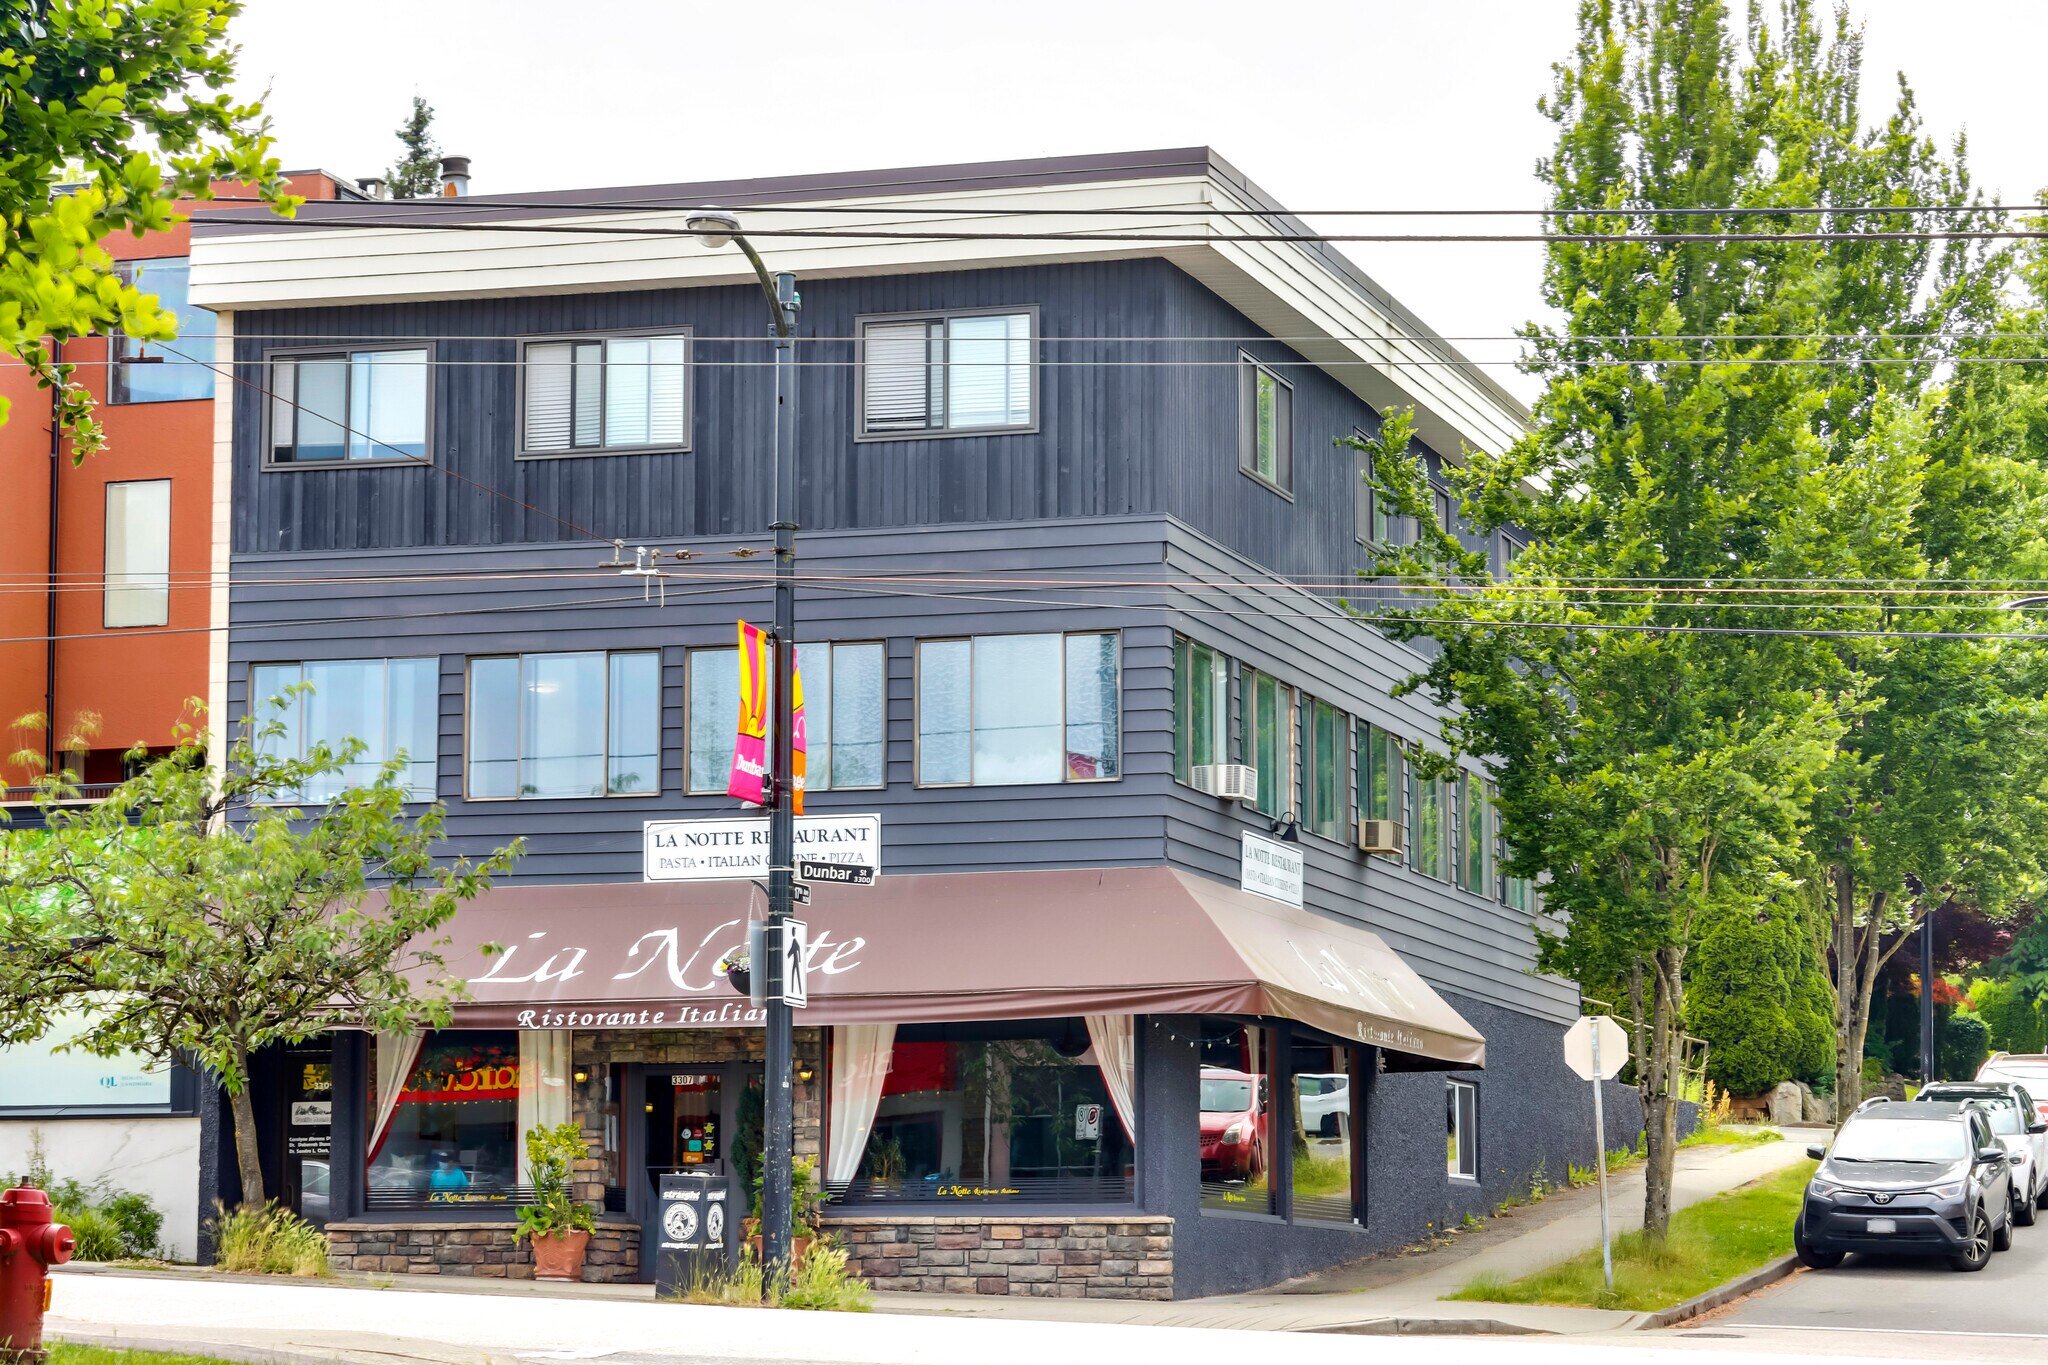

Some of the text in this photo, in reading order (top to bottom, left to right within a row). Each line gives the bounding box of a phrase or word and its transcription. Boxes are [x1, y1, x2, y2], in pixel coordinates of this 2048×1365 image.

[656, 827, 870, 848] LA NOTTE REAURANT
[660, 857, 697, 869] PASTA
[708, 854, 761, 868] ITALIAN
[830, 852, 865, 863] PIZZA
[803, 865, 852, 880] Dunbar
[854, 876, 871, 884] 3300
[467, 918, 866, 991] La Note
[517, 1002, 767, 1030] Ristorante Italia
[100, 1076, 117, 1088] QL
[672, 1076, 693, 1085] 3307
[937, 1186, 947, 1195] La
[950, 1185, 971, 1197] Notte
